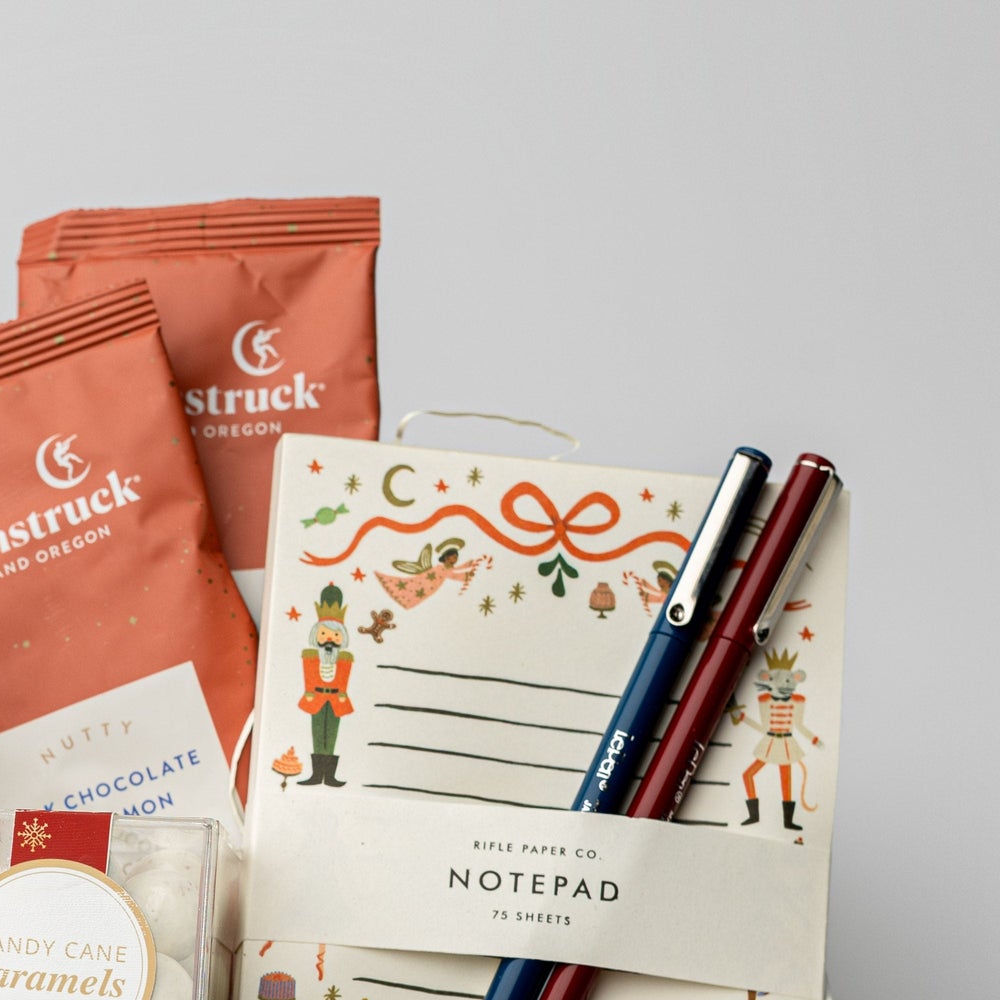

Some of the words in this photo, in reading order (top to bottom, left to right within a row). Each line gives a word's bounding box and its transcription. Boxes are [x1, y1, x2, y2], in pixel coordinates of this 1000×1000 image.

[184, 371, 321, 416] struck
[202, 421, 282, 439] OREGON
[34, 524, 112, 563] OREGON
[39, 720, 133, 765] NUTTY
[63, 749, 201, 810] CHOCOLATE
[123, 792, 174, 817] MON
[473, 840, 513, 853] RIFLE
[521, 844, 567, 857] PAPER
[575, 848, 603, 861] CO.
[449, 867, 620, 902] NOTEPAD
[491, 909, 508, 920] 75
[515, 911, 571, 926] SHEETS
[64, 941, 128, 963] CANE
